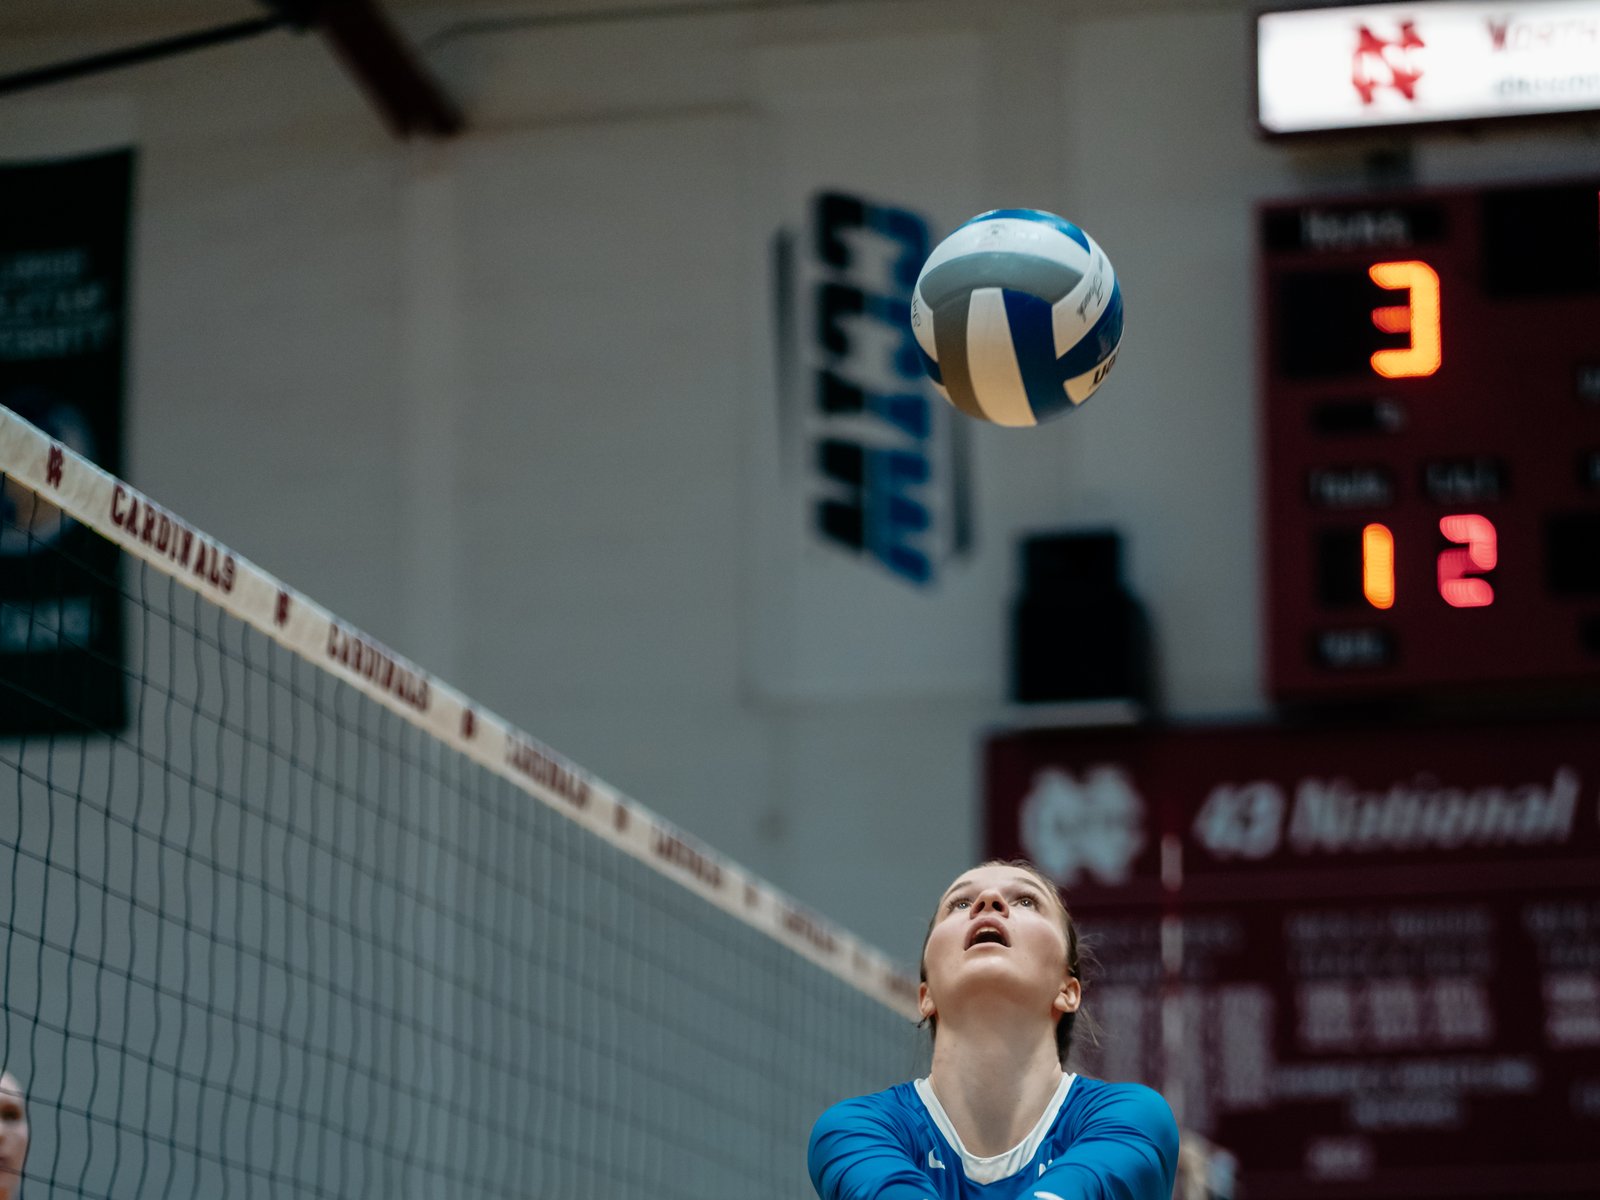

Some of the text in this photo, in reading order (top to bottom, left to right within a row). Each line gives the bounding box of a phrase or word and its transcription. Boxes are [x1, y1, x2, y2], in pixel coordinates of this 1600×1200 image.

[1369, 260, 1440, 378] 3
[110, 484, 237, 594] CARDINALS
[1363, 523, 1394, 609] 1
[1437, 514, 1497, 607] 2
